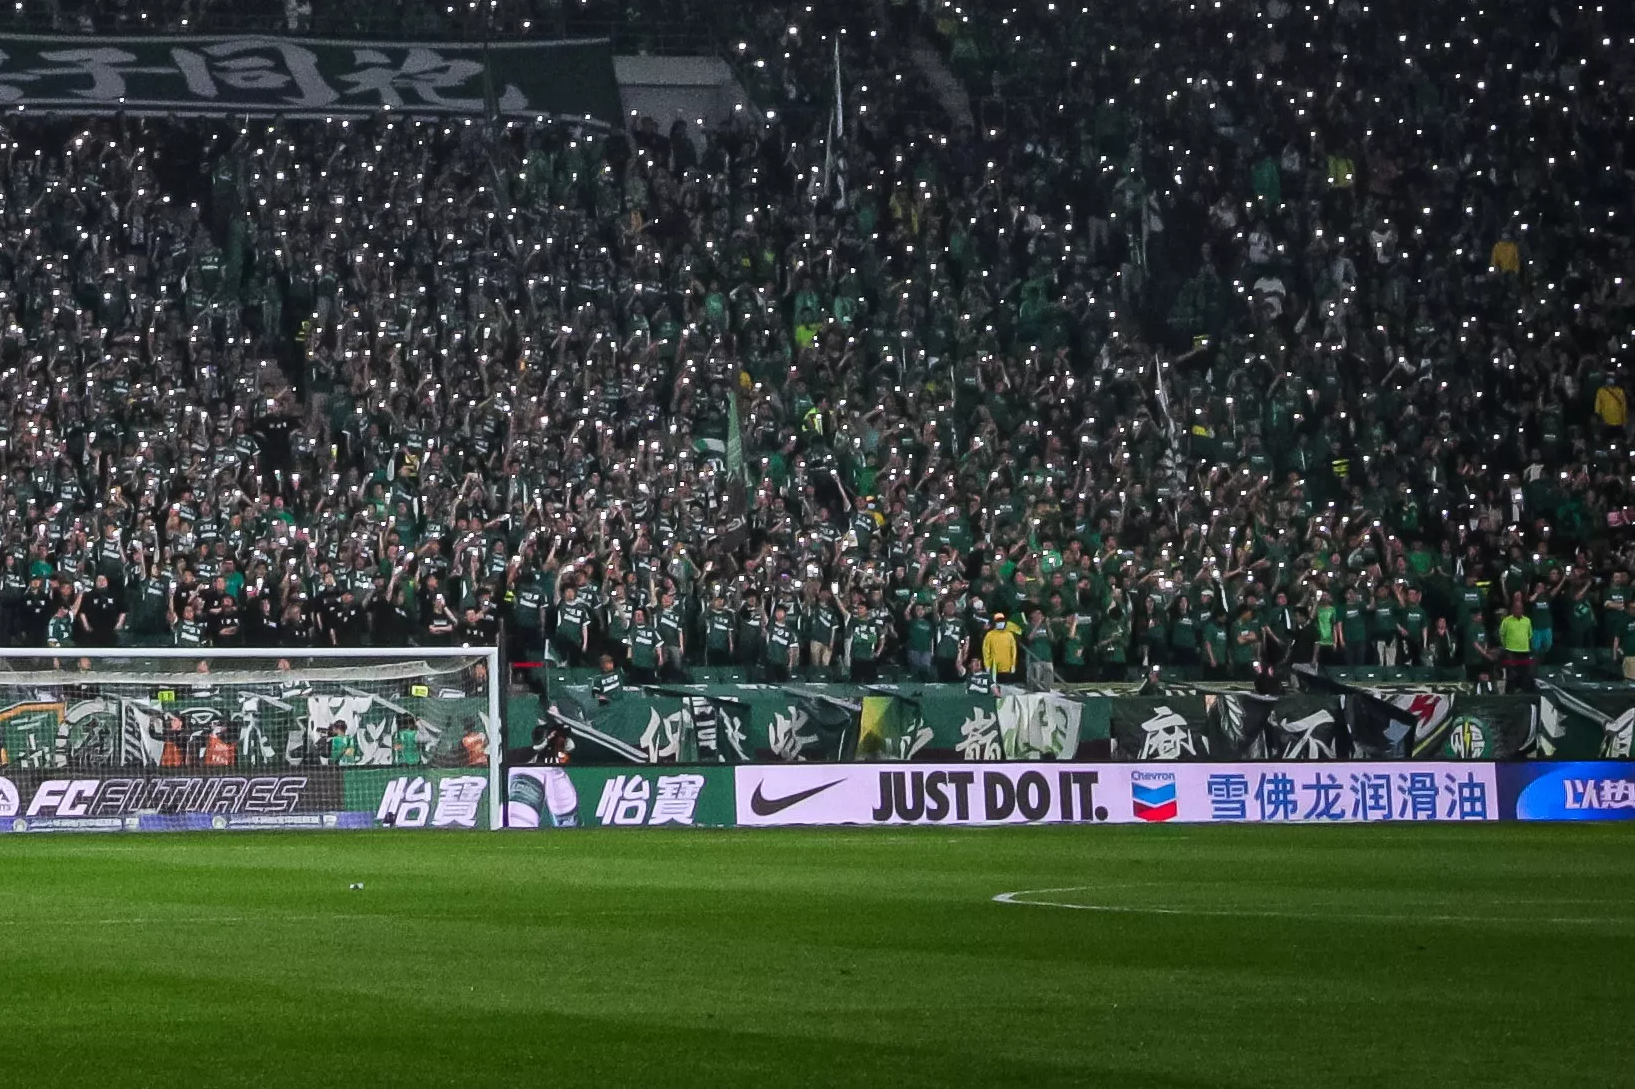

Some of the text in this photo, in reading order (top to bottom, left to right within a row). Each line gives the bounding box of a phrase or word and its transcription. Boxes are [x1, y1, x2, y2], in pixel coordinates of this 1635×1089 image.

[377, 774, 487, 828] 怡寶
[596, 774, 705, 826] 怡寶
[872, 771, 1109, 822] JUST DO IT.
[1131, 771, 1176, 781] Chevron
[1206, 771, 1488, 821] 雪佛龙润滑油
